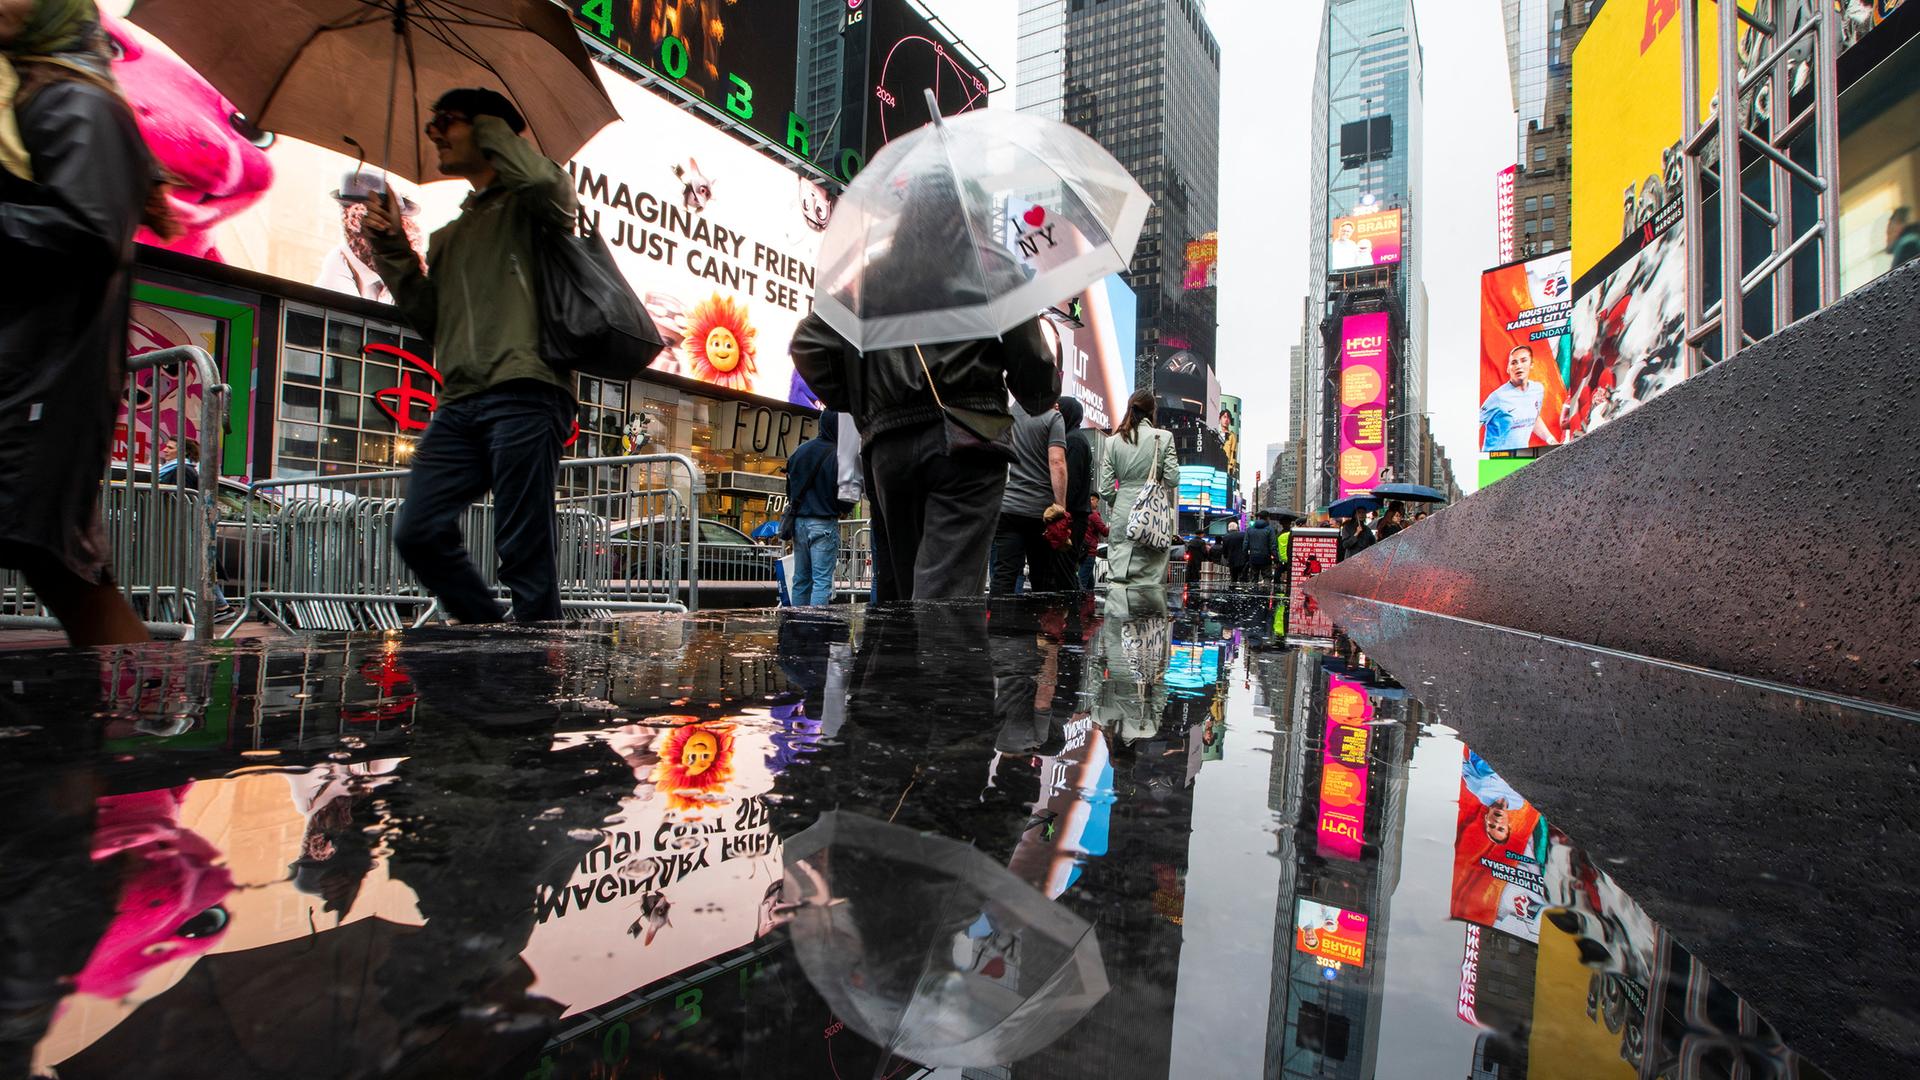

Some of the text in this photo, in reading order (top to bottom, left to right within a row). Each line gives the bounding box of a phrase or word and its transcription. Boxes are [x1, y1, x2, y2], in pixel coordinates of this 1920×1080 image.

[848, 11, 863, 25] LG
[933, 41, 943, 56] LG
[972, 75, 988, 97] TECH
[876, 86, 895, 108] 2024
[569, 160, 746, 259] IMAGINARY
[1357, 218, 1397, 233] BRAIN
[1015, 222, 1057, 260] NY
[611, 220, 678, 266] JUST
[687, 249, 758, 296] CAN'T
[765, 279, 798, 312] SEE
[1518, 304, 1559, 319] HOUSTON
[1506, 315, 1543, 331] KANSAS
[1543, 311, 1565, 323] CITY
[1530, 327, 1565, 340] SUNDAY
[1346, 336, 1382, 350] HFCU
